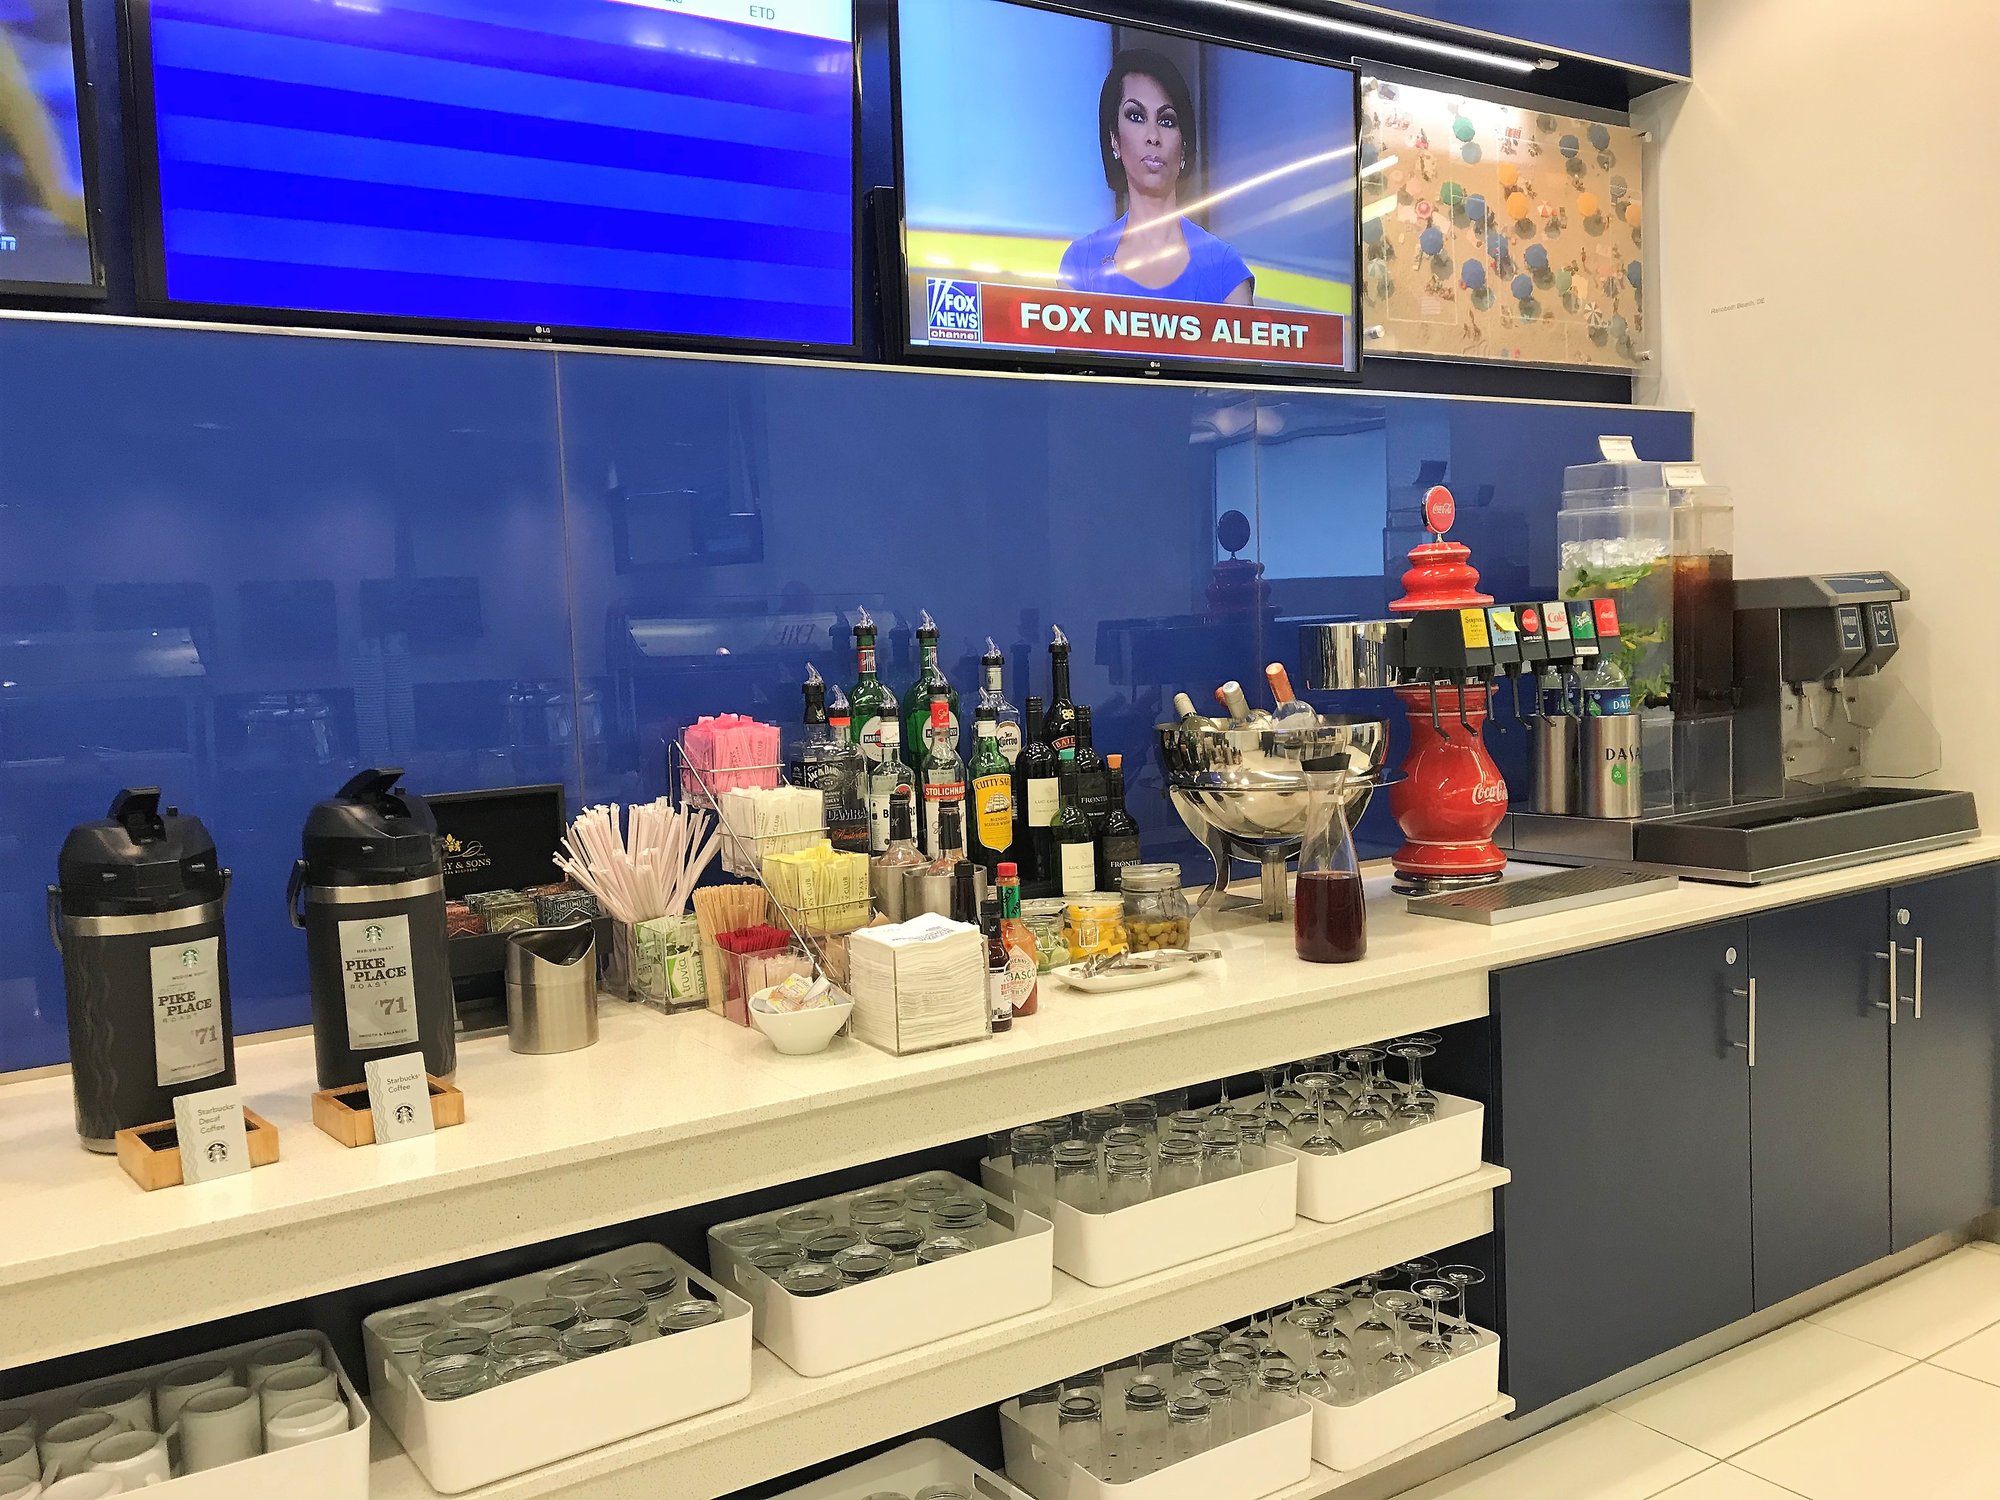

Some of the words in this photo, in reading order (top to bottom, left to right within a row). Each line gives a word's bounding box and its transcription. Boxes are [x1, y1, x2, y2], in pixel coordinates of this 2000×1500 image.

[749, 5, 775, 21] ETD
[945, 293, 976, 313] FOX
[936, 311, 978, 329] NEWS
[1020, 302, 1093, 334] FOX
[1104, 309, 1201, 342] NEWS
[1211, 318, 1309, 349] ALERT
[931, 328, 978, 341] channel
[1548, 611, 1565, 624] Coke
[1875, 610, 1888, 625] ICE
[976, 777, 999, 791] CUTTY
[455, 861, 464, 869] &
[465, 857, 491, 868] SONS
[345, 957, 386, 972] PIKE
[353, 966, 407, 983] PLACE
[350, 981, 388, 990] ROAST
[157, 990, 196, 1007] PIKE
[166, 998, 212, 1017] PLACE
[388, 1084, 411, 1094] Coffee
[199, 1114, 221, 1126] Decaf
[200, 1123, 226, 1135] Coffee
